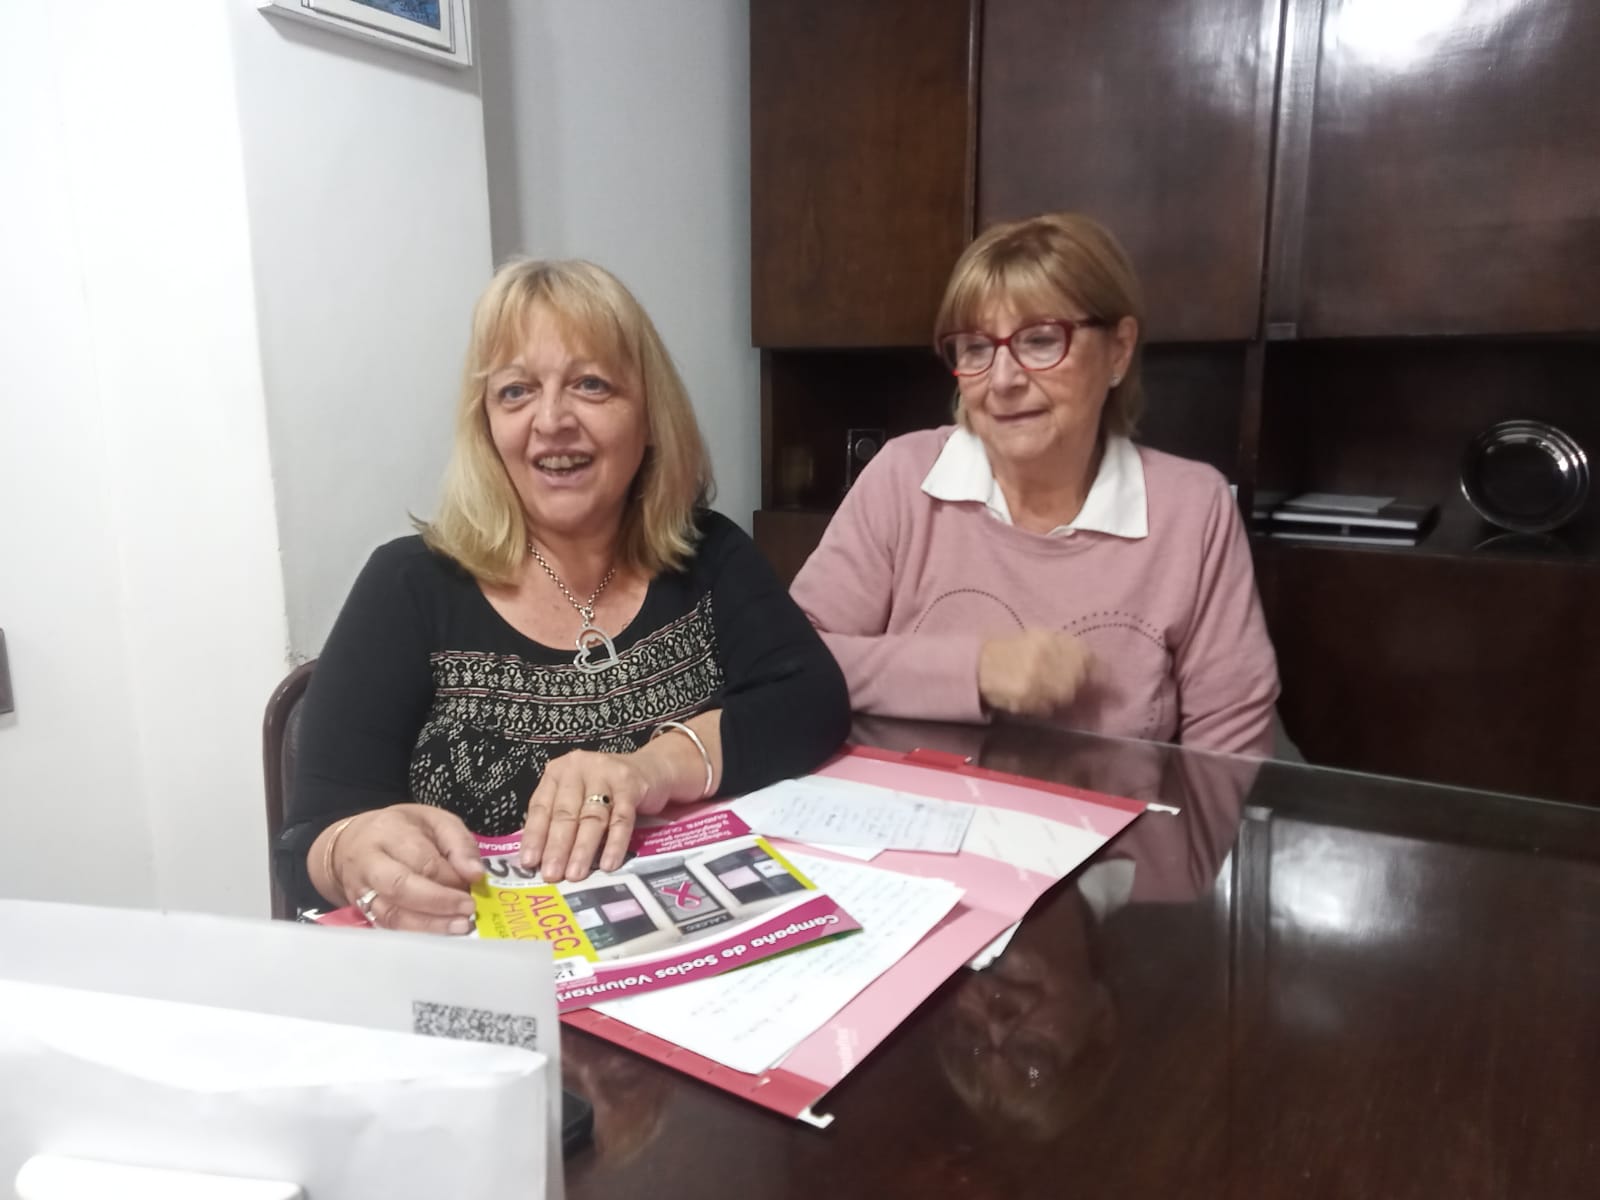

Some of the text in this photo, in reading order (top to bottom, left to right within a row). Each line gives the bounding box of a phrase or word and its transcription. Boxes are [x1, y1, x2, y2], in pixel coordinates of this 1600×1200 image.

[526, 895, 581, 951] ALCEC
[751, 914, 840, 948] Campaña
[655, 953, 719, 979] Socios
[721, 943, 747, 959] de
